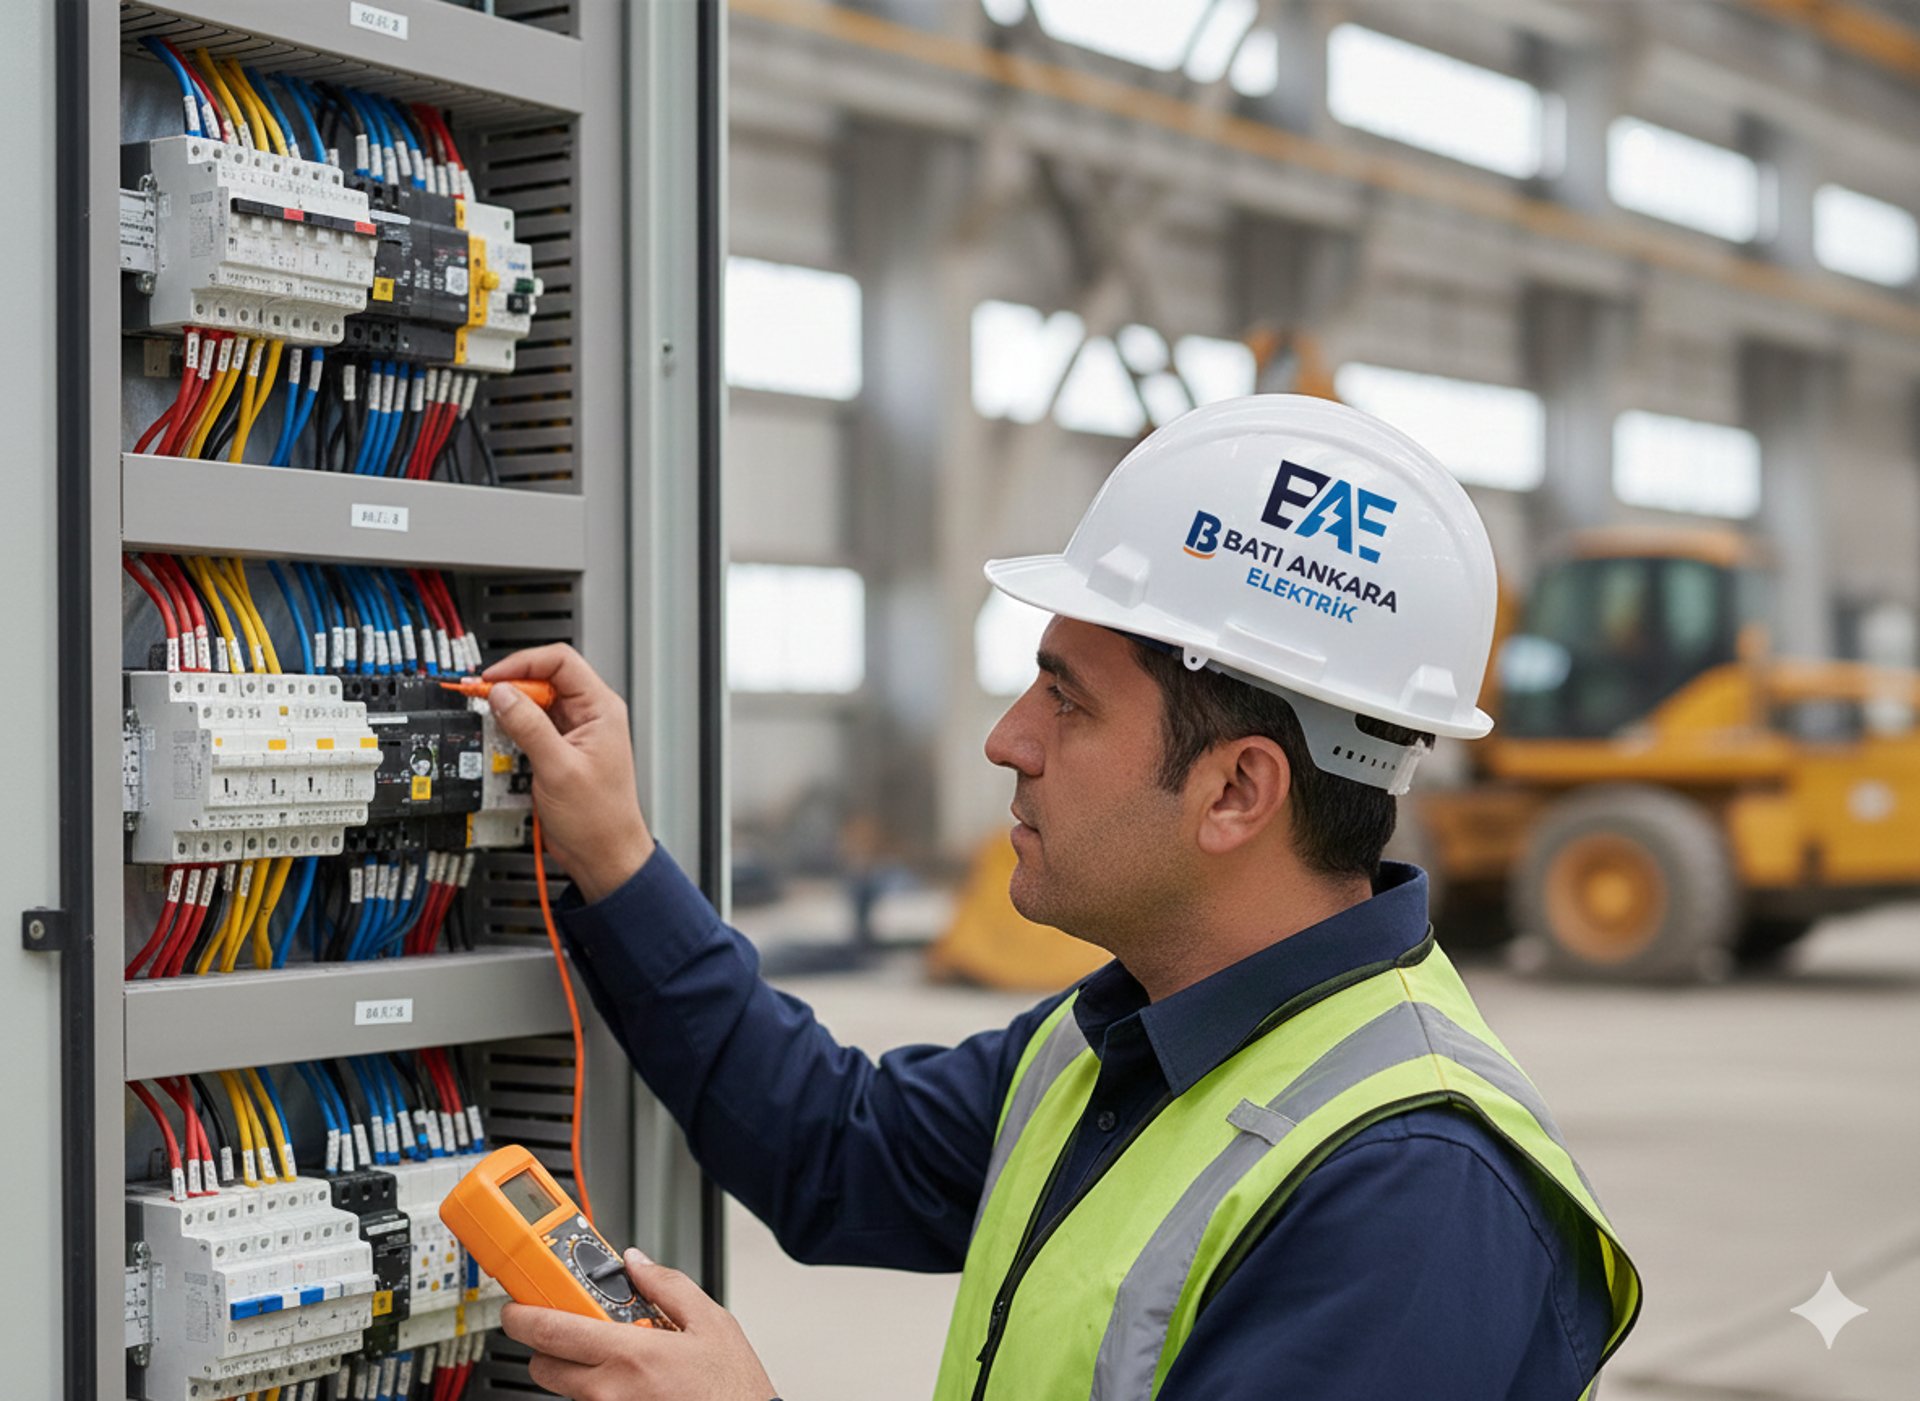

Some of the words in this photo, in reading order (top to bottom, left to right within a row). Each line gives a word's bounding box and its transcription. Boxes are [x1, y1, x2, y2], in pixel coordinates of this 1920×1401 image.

[1222, 529, 1284, 568] BATI
[1286, 556, 1397, 613] ANKARA
[1246, 567, 1358, 623] ELEKTRİK
